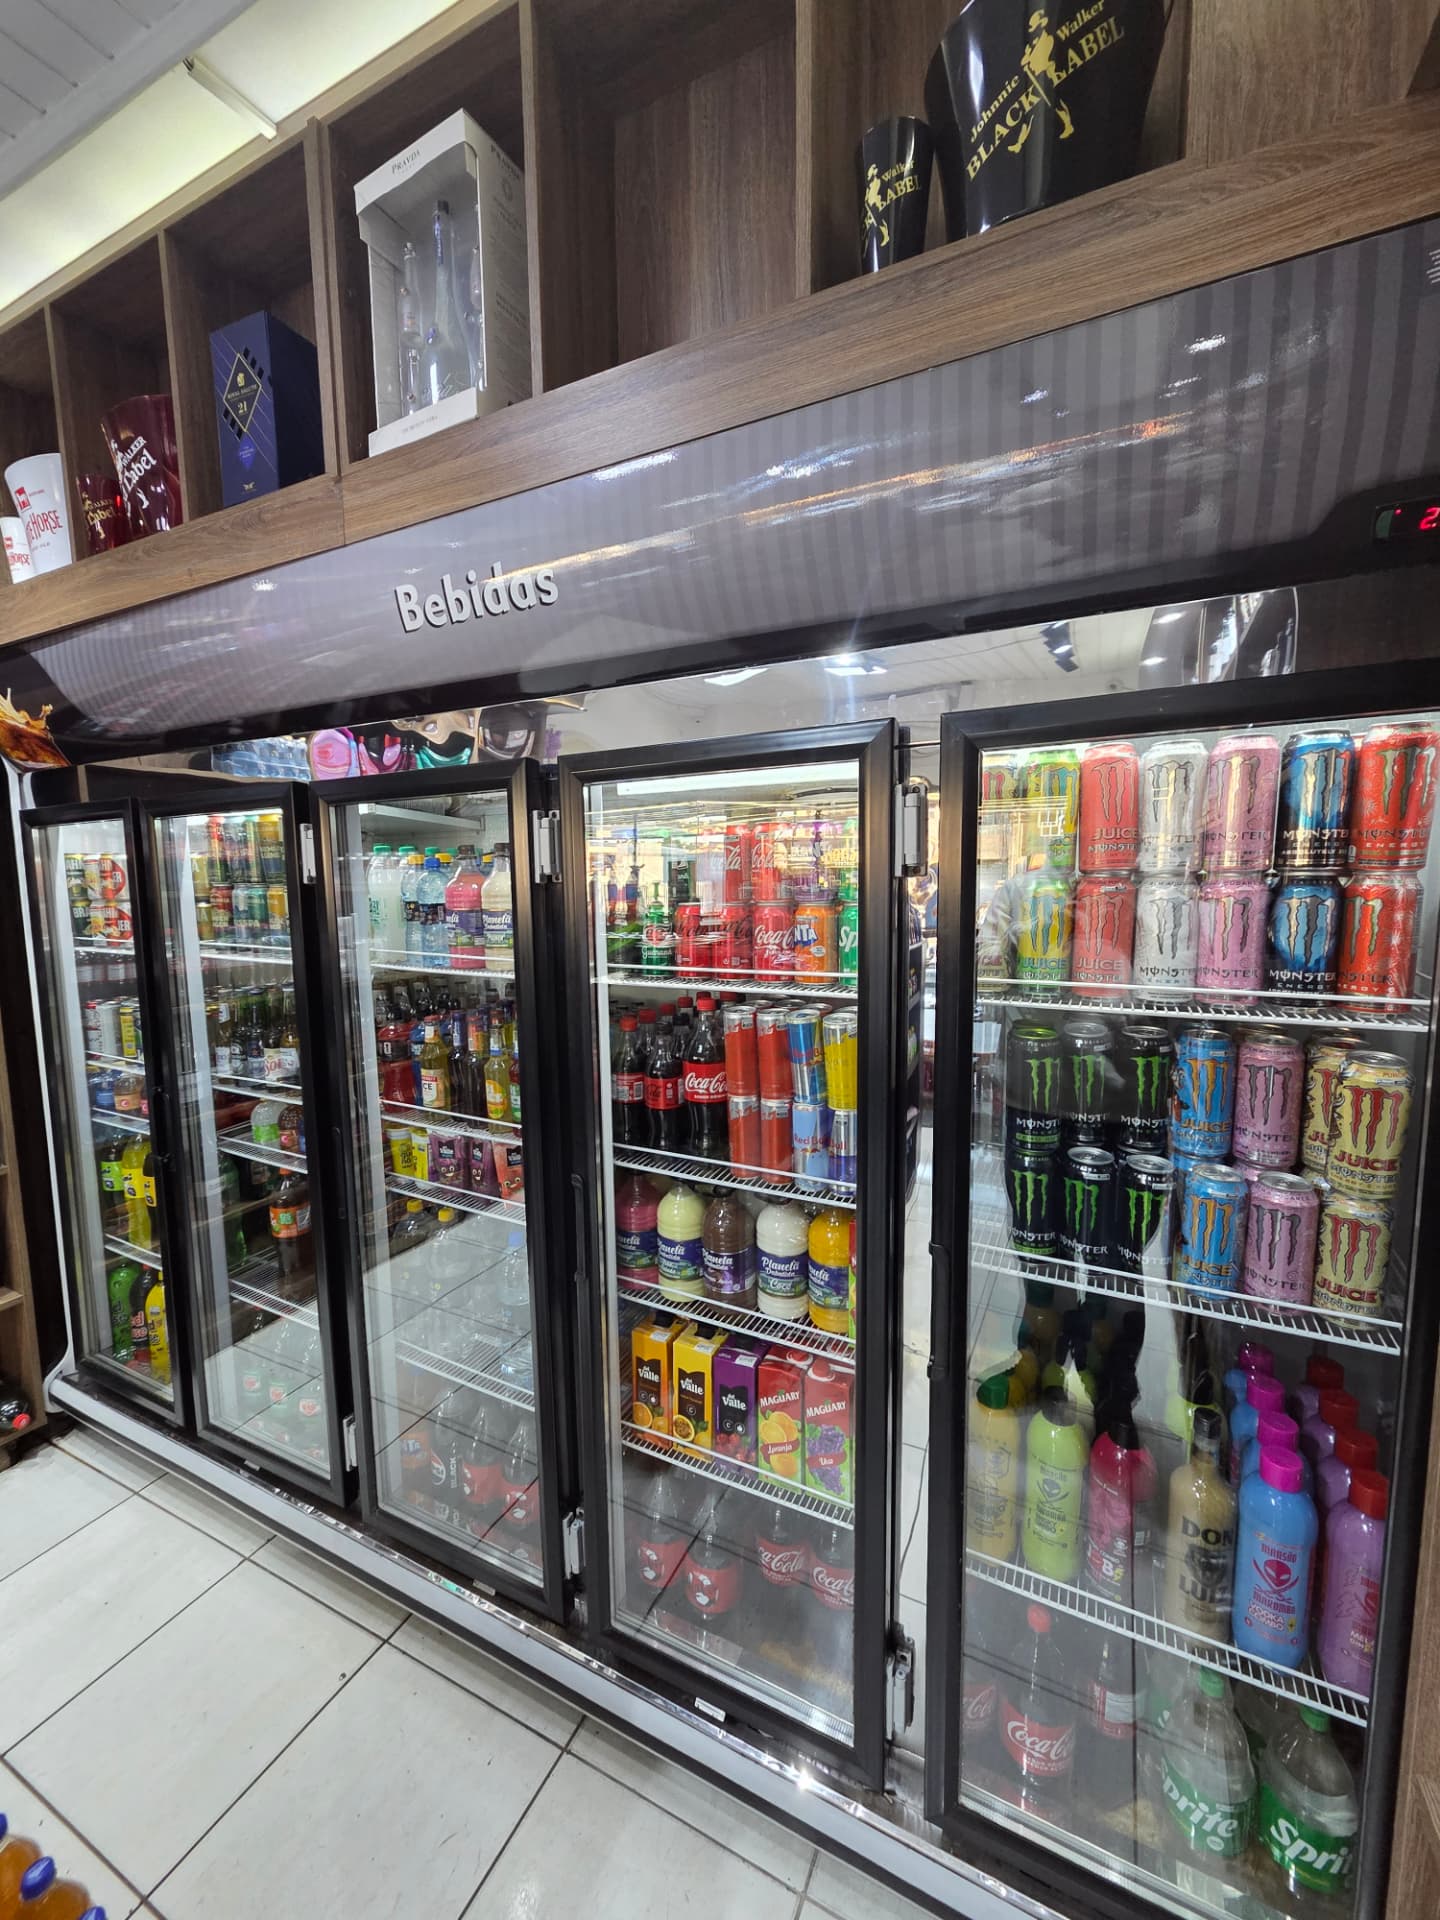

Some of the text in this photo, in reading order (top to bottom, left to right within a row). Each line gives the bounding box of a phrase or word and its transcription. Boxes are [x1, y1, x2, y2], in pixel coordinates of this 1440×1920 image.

[1056, 1, 1105, 43] Walker
[966, 86, 1042, 181] BLACK
[124, 448, 157, 493] Label
[395, 561, 560, 632] Bebidas
[1283, 828, 1349, 841] MONSTE
[1357, 828, 1428, 840] MONSTE
[1075, 957, 1125, 970] JUICE
[1269, 968, 1337, 983] MONSTER
[1067, 1111, 1110, 1124] ONST
[1235, 1126, 1292, 1143] MONSTE
[1334, 1149, 1398, 1172] JUICE
[1316, 1275, 1377, 1304] JUICE
[638, 1367, 660, 1383] Valle
[680, 1380, 704, 1396] Valle
[722, 1395, 747, 1411] Valle
[760, 1391, 800, 1408] MAGUARY
[806, 1401, 846, 1418] MAGUARY
